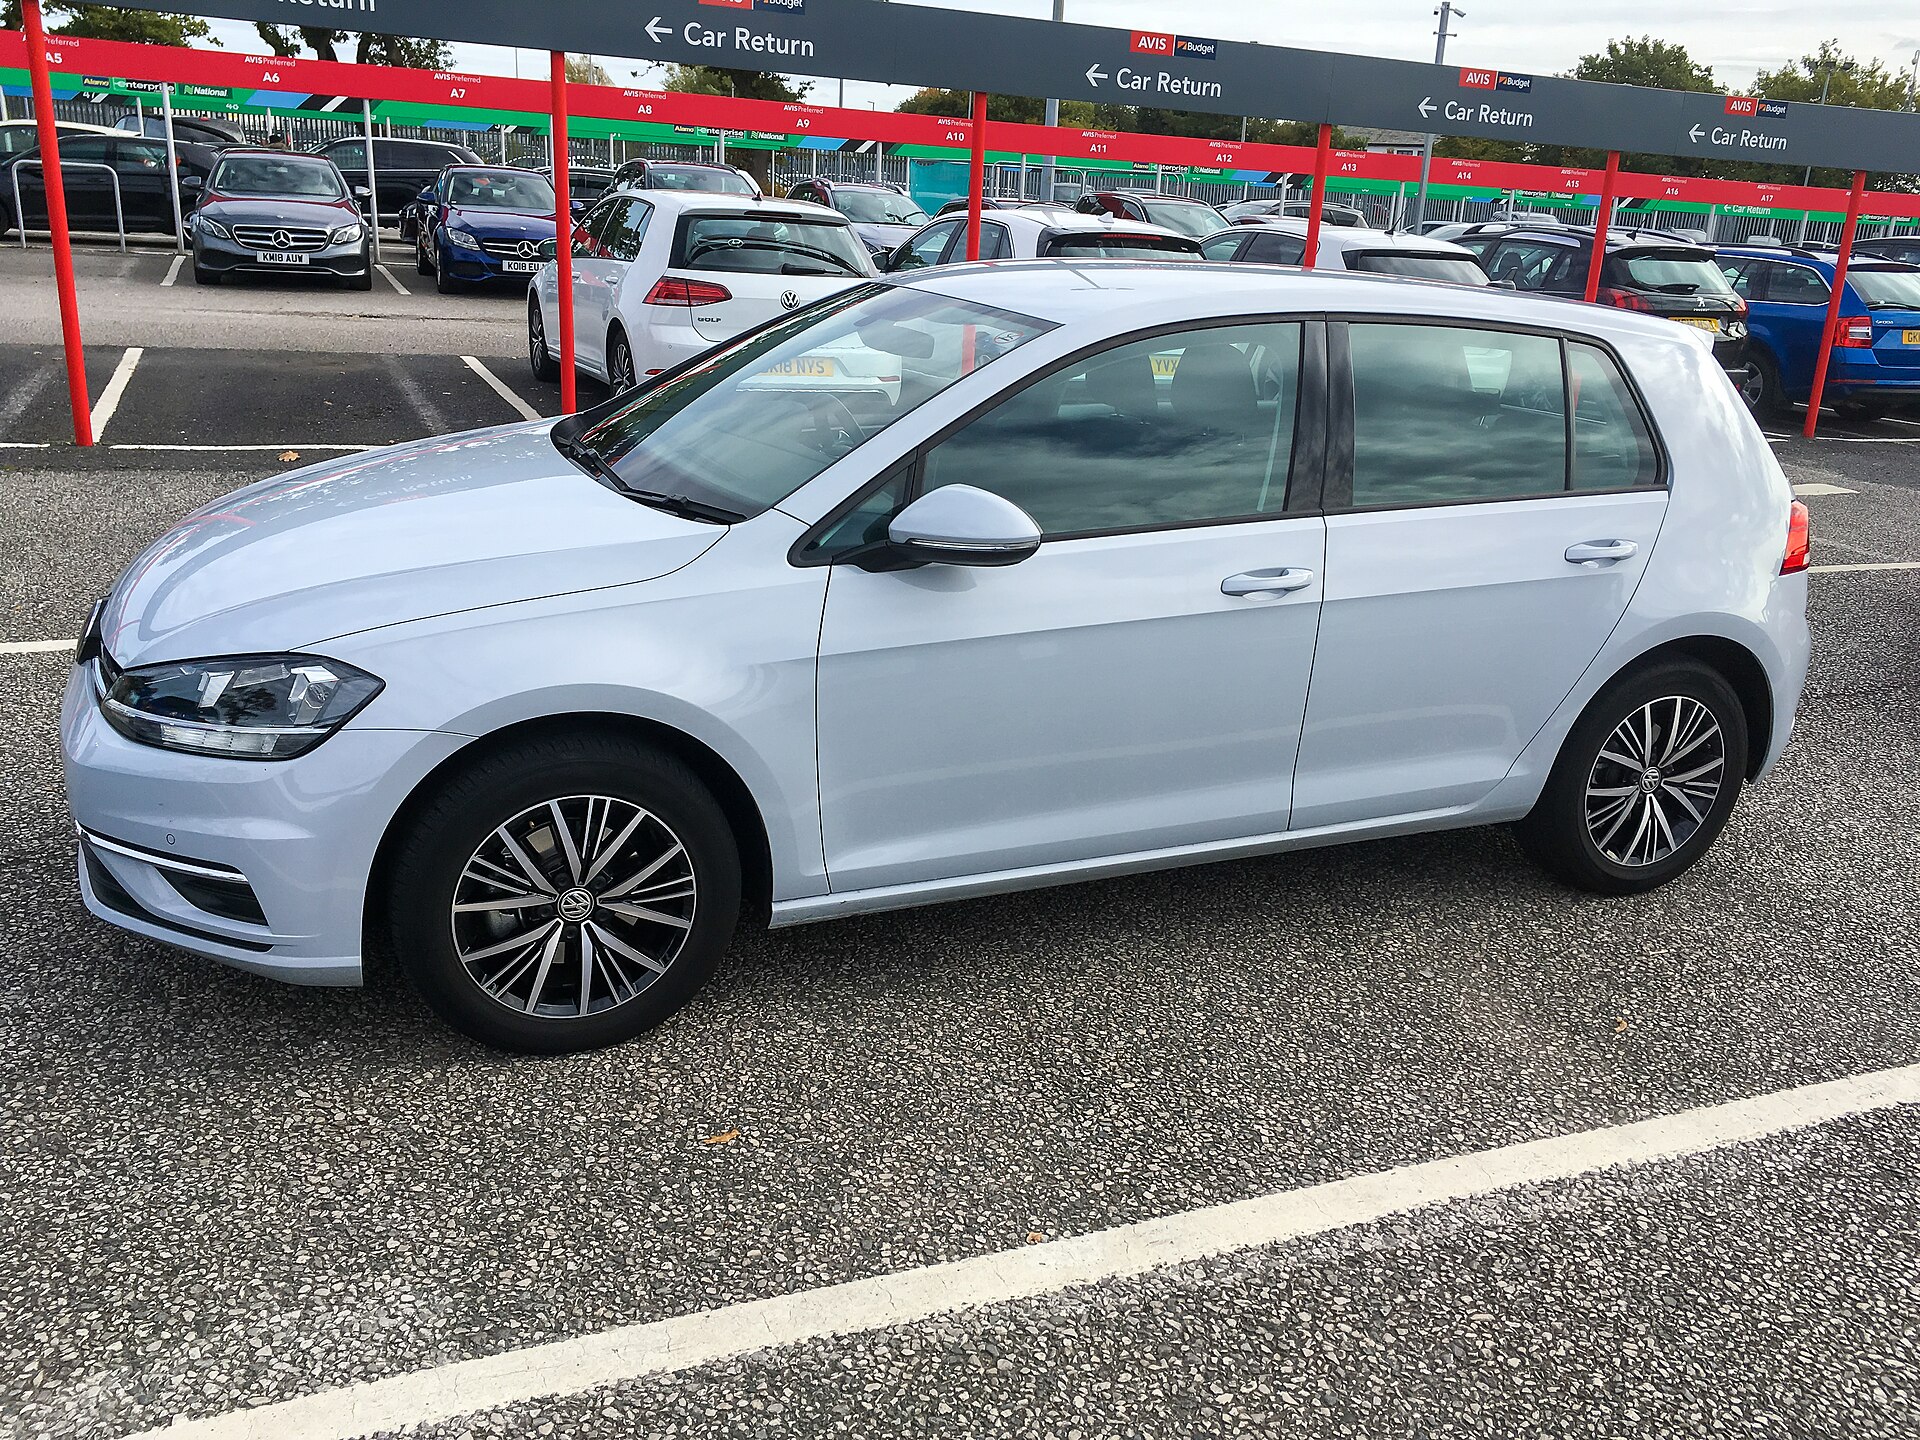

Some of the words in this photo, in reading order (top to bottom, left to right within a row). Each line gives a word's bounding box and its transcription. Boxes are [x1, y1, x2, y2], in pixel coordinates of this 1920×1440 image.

[278, 0, 376, 12] urn
[770, 0, 804, 9] get
[684, 22, 727, 48] Car
[735, 27, 814, 57] Return
[1137, 36, 1167, 51] AVIS
[1187, 42, 1215, 55] Budget
[45, 52, 63, 64] A5
[262, 71, 280, 83] A6
[1466, 72, 1491, 85] AVIS
[114, 80, 175, 92] enterprie
[1116, 68, 1151, 91] Car
[1157, 72, 1222, 98] Return
[1507, 77, 1531, 89] Budget
[193, 86, 228, 97] National
[450, 88, 466, 98] A7
[637, 104, 653, 115] A8
[1730, 100, 1752, 112] AVIS
[1766, 104, 1786, 115] Budget
[1445, 101, 1474, 121] Car
[1479, 104, 1533, 127] Return
[796, 118, 810, 129] A9
[698, 127, 744, 137] enteprise
[758, 131, 785, 141] National
[945, 131, 965, 142] A10
[1711, 127, 1737, 145] Car
[1740, 130, 1787, 150] Return
[1089, 143, 1107, 153] A11
[1215, 153, 1233, 163] A12
[1151, 164, 1188, 173] eterprise
[1341, 163, 1357, 171] A13
[1456, 171, 1472, 180] A14
[1565, 180, 1579, 188] A15
[1665, 187, 1679, 195] A16
[1732, 204, 1745, 213] Car
[1747, 206, 1771, 215] Return
[528, 262, 545, 272] EU
[796, 360, 825, 374] NYS
